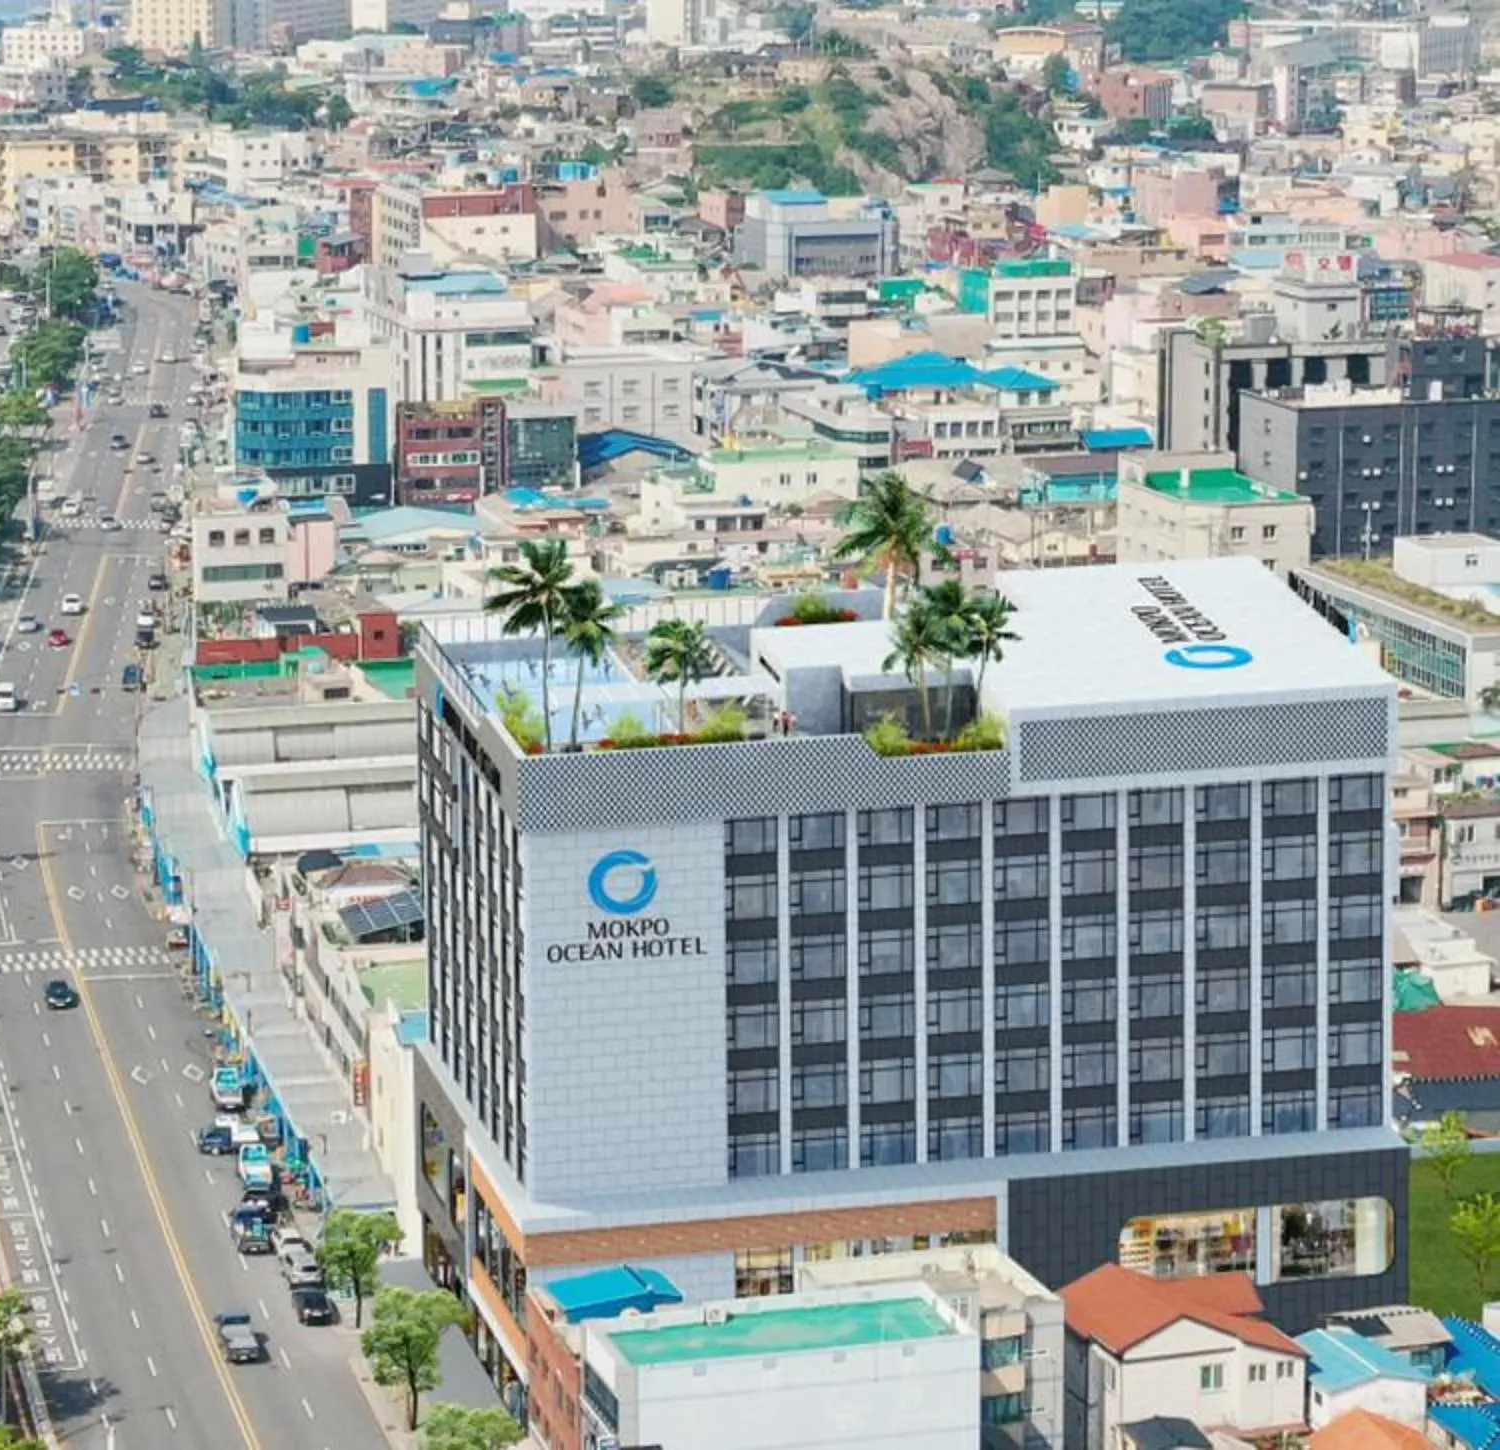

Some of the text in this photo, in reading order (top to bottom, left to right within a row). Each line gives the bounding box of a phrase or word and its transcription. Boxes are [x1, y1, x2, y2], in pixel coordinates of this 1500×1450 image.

[587, 917, 670, 940] MOKPO
[547, 937, 708, 963] OCEAN HOTEL
